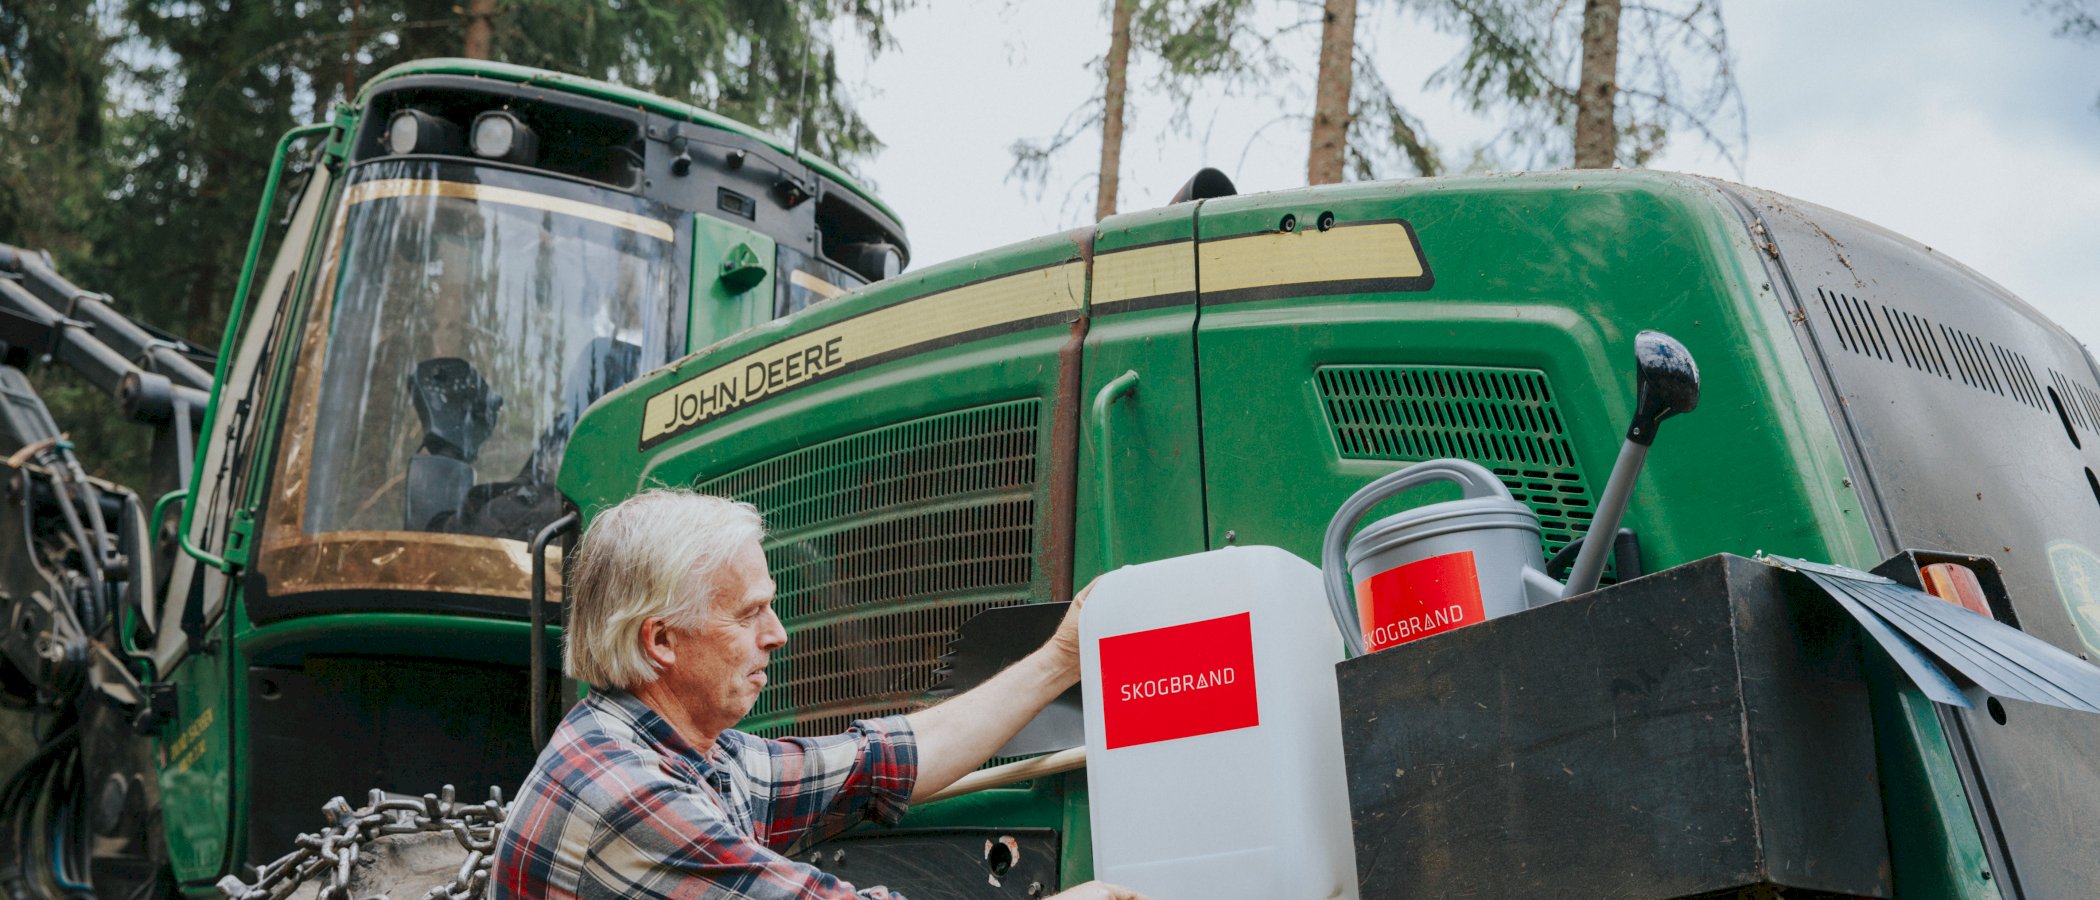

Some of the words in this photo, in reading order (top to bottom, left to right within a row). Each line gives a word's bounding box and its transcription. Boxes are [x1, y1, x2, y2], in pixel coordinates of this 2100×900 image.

[664, 376, 737, 429] JOHN
[745, 336, 843, 397] DEERE
[1362, 604, 1464, 651] SKOGBRAND
[1120, 667, 1235, 702] SKOGBRAND
